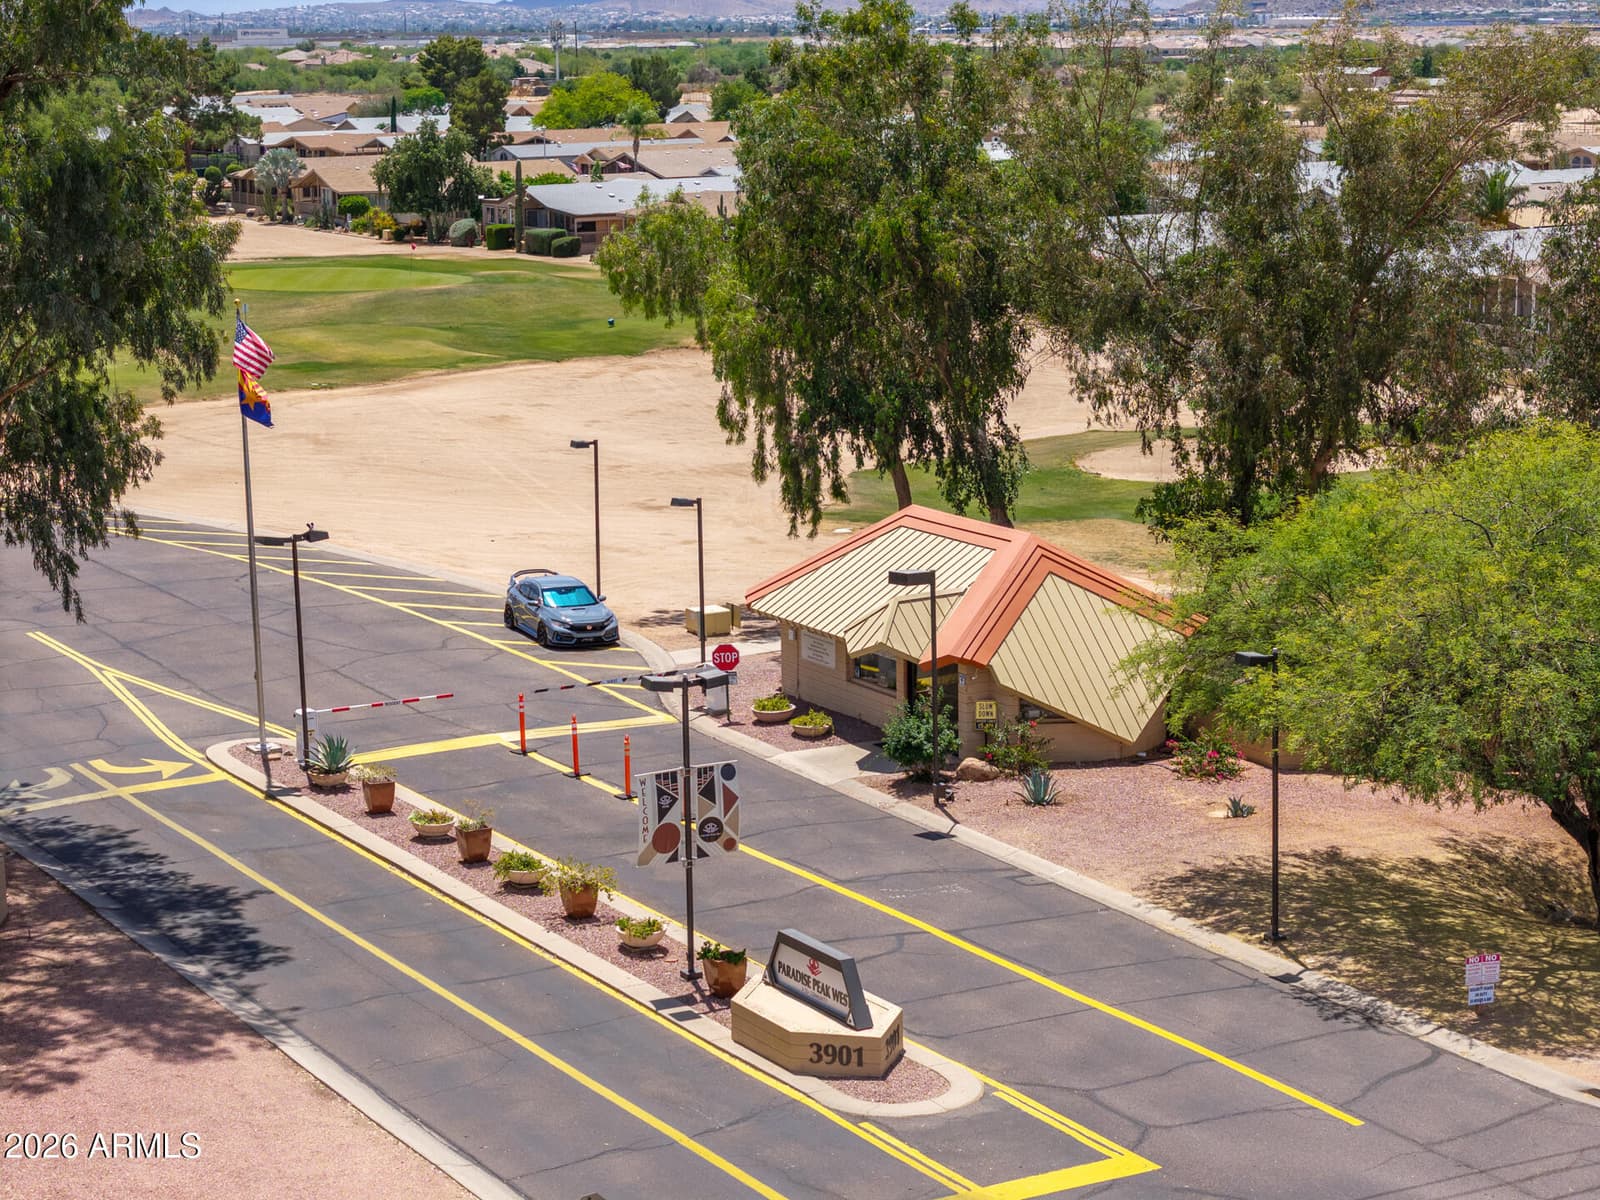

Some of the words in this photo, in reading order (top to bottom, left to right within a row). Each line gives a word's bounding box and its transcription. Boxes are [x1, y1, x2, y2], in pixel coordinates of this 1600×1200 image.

[713, 652, 738, 664] STOP
[639, 778, 649, 843] WELCOME
[777, 961, 812, 989] PARADISE
[812, 978, 831, 999] PEAK
[831, 987, 849, 1007] WES
[809, 1042, 864, 1068] 3901
